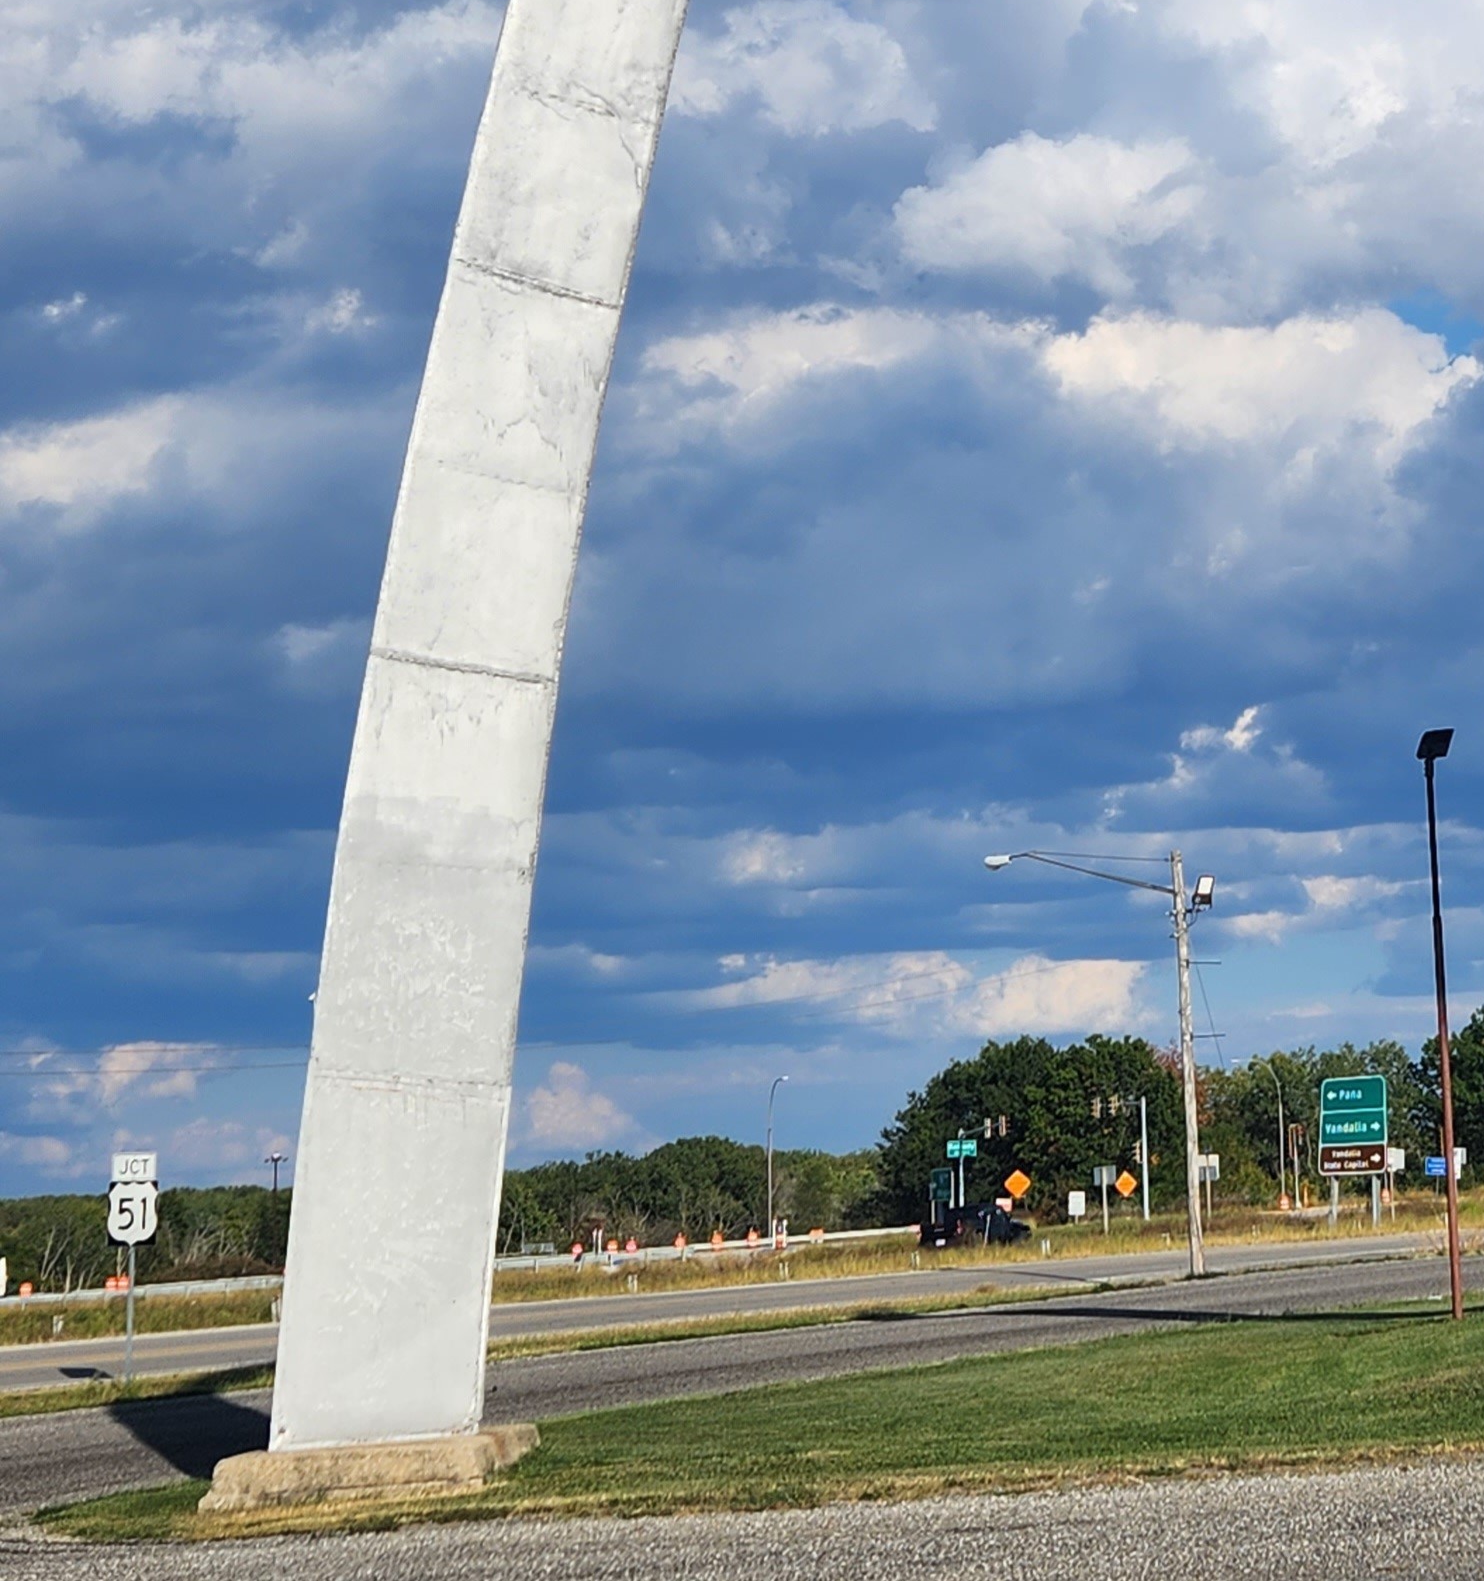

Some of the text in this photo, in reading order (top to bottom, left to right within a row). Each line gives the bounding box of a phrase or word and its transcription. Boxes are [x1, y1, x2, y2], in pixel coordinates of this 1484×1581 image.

[1339, 1089, 1362, 1100] Pana
[1325, 1121, 1367, 1134] Vandalia
[119, 1158, 149, 1174] JCT
[118, 1197, 147, 1230] 51
